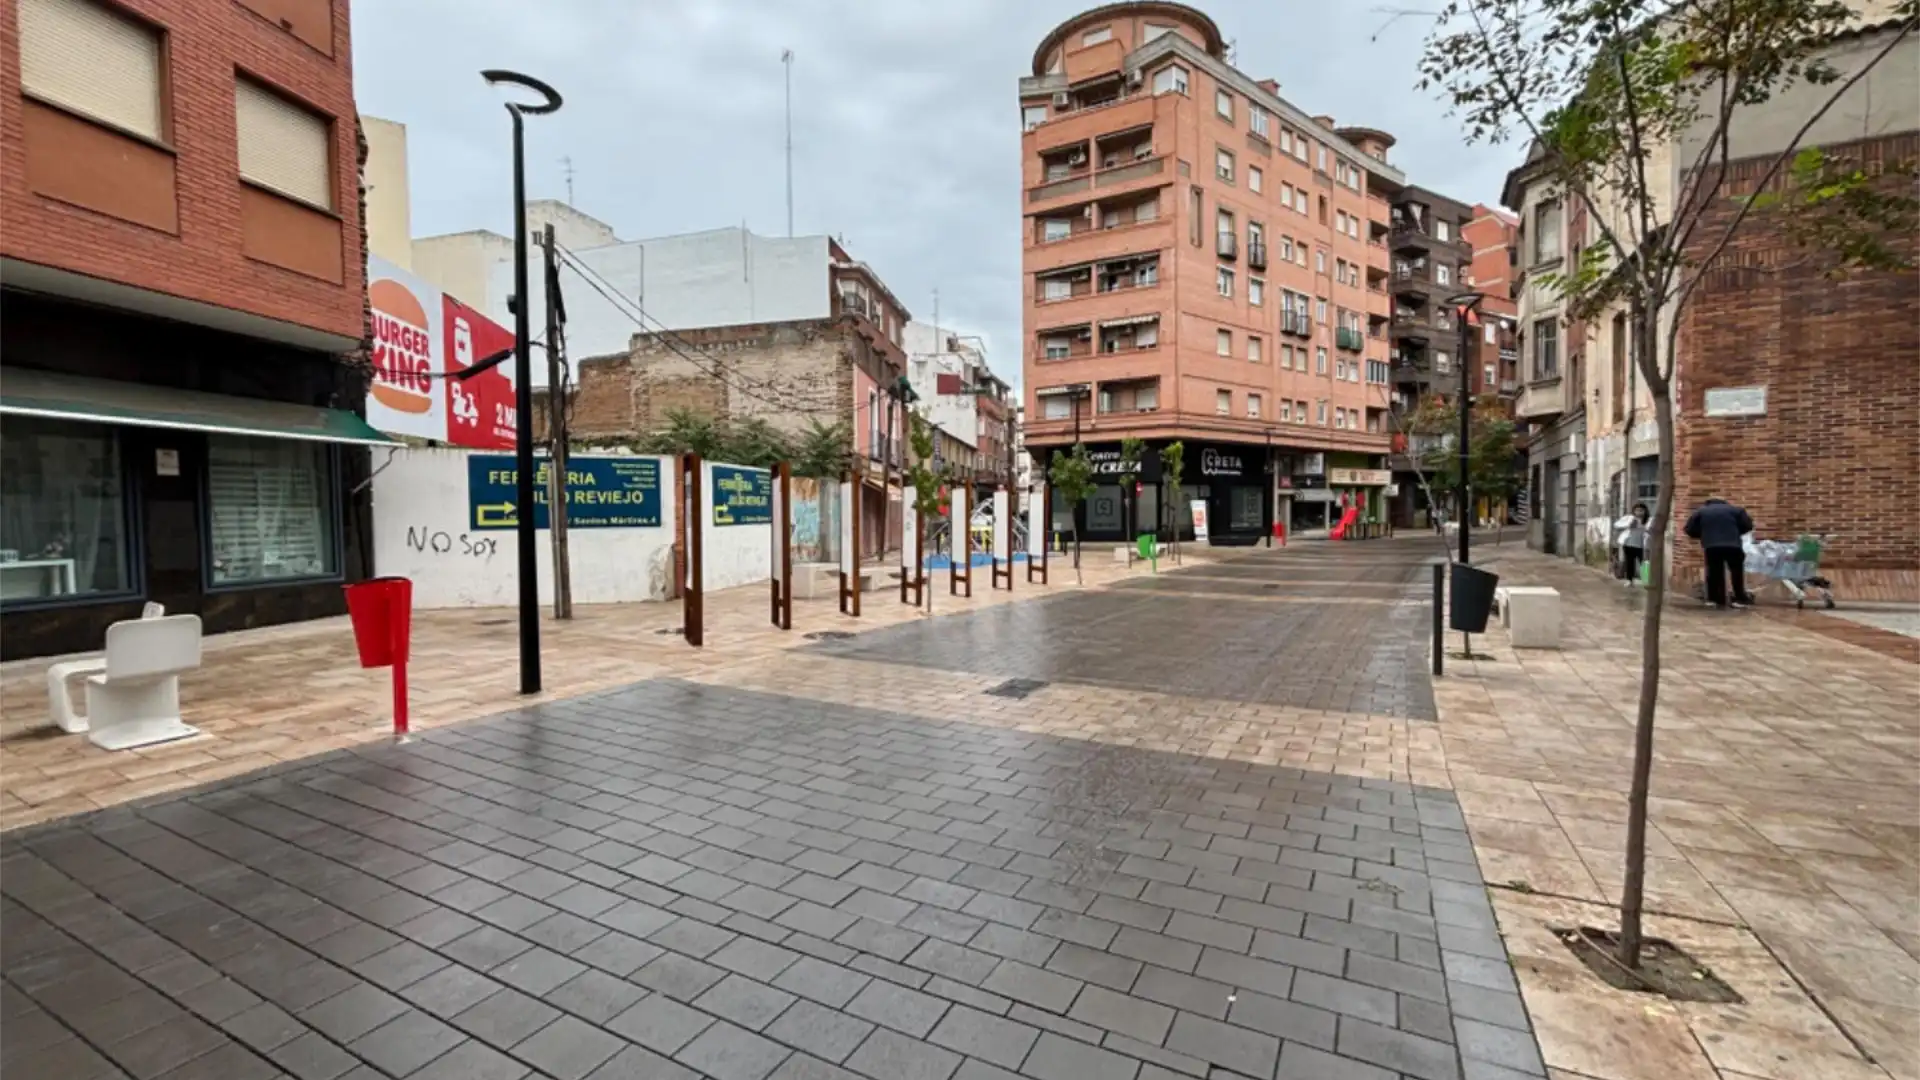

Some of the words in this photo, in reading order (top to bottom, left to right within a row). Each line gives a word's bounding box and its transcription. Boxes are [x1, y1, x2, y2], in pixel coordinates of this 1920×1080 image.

[371, 313, 430, 359] BURGER
[372, 344, 432, 394] KING
[1207, 454, 1243, 468] CRETA
[574, 489, 644, 505] REVIEJO
[407, 526, 451, 553] NO
